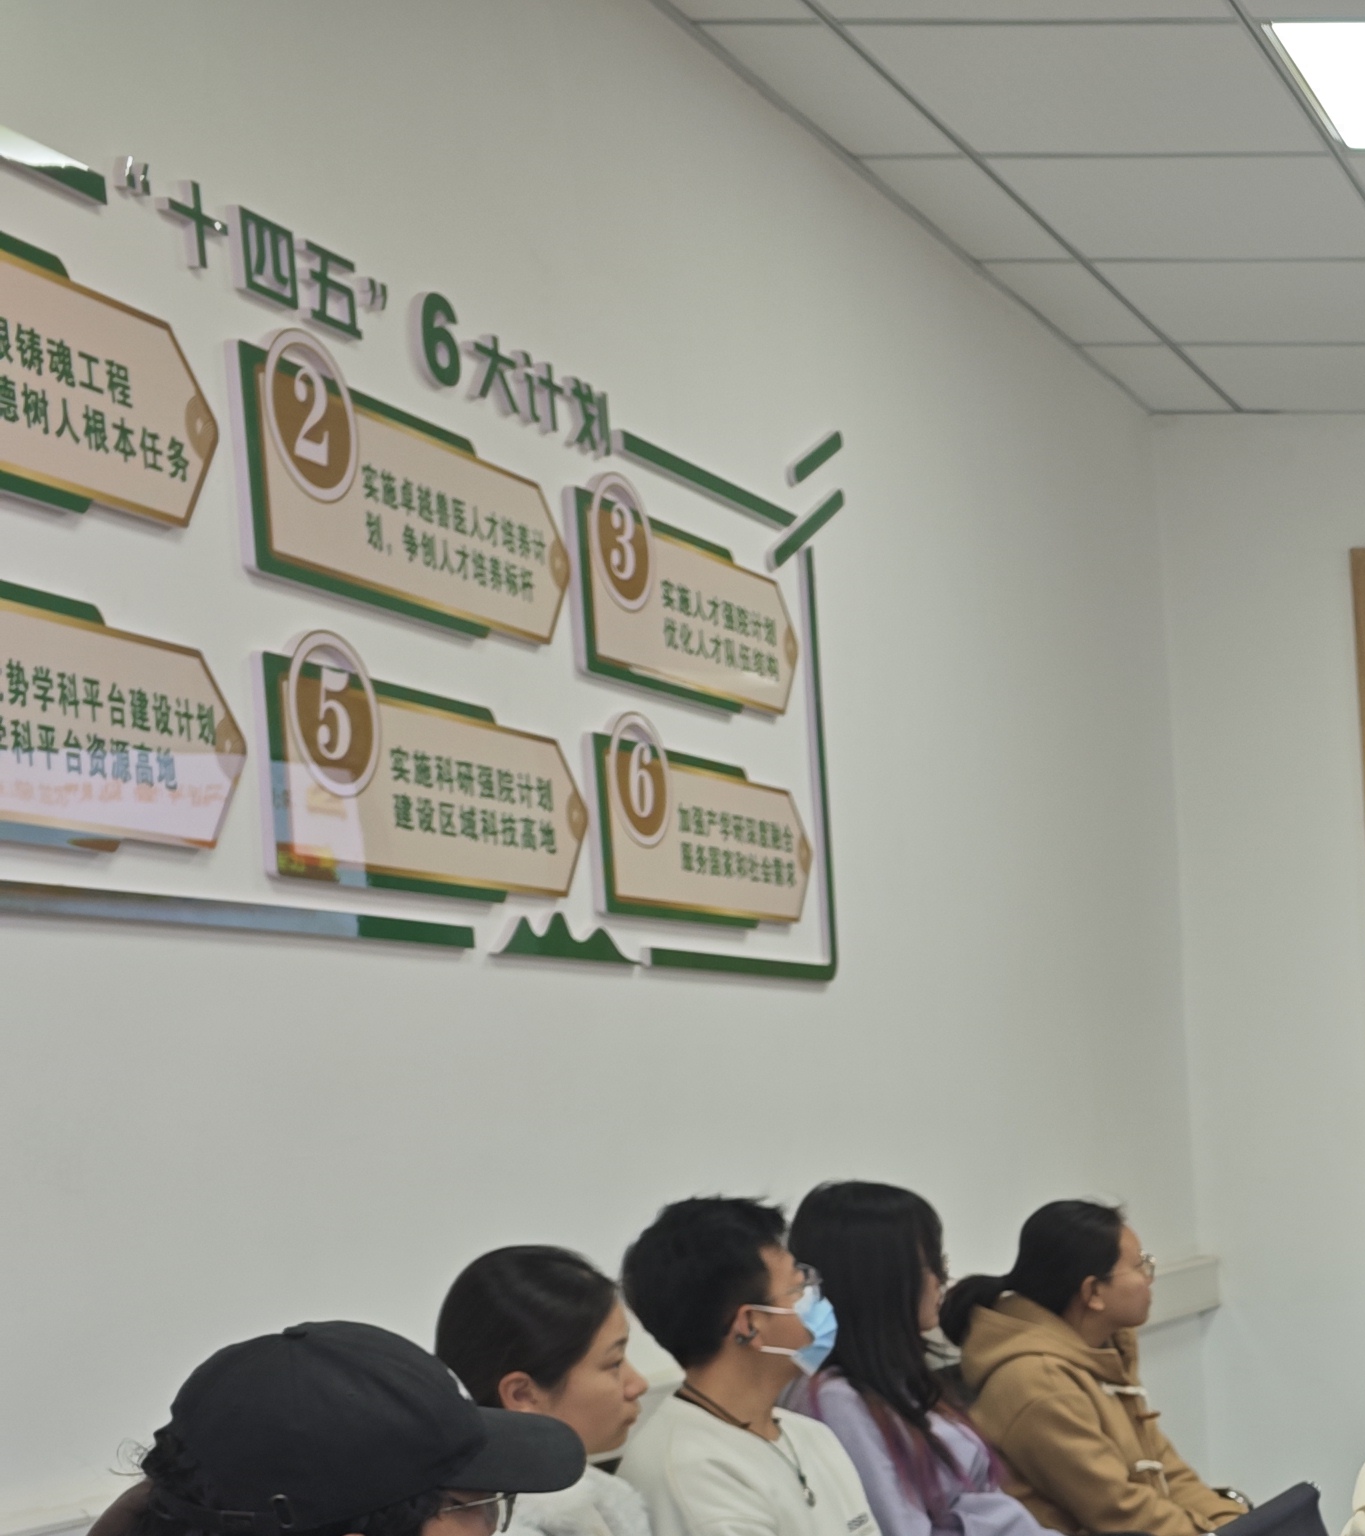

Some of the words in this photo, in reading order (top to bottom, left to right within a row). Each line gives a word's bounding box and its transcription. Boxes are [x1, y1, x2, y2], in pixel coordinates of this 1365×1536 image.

[294, 366, 328, 467] 2
[610, 502, 636, 580] 3
[0, 657, 216, 746] 势学科平台建设计划
[317, 665, 351, 760] 5
[629, 741, 654, 818] 6
